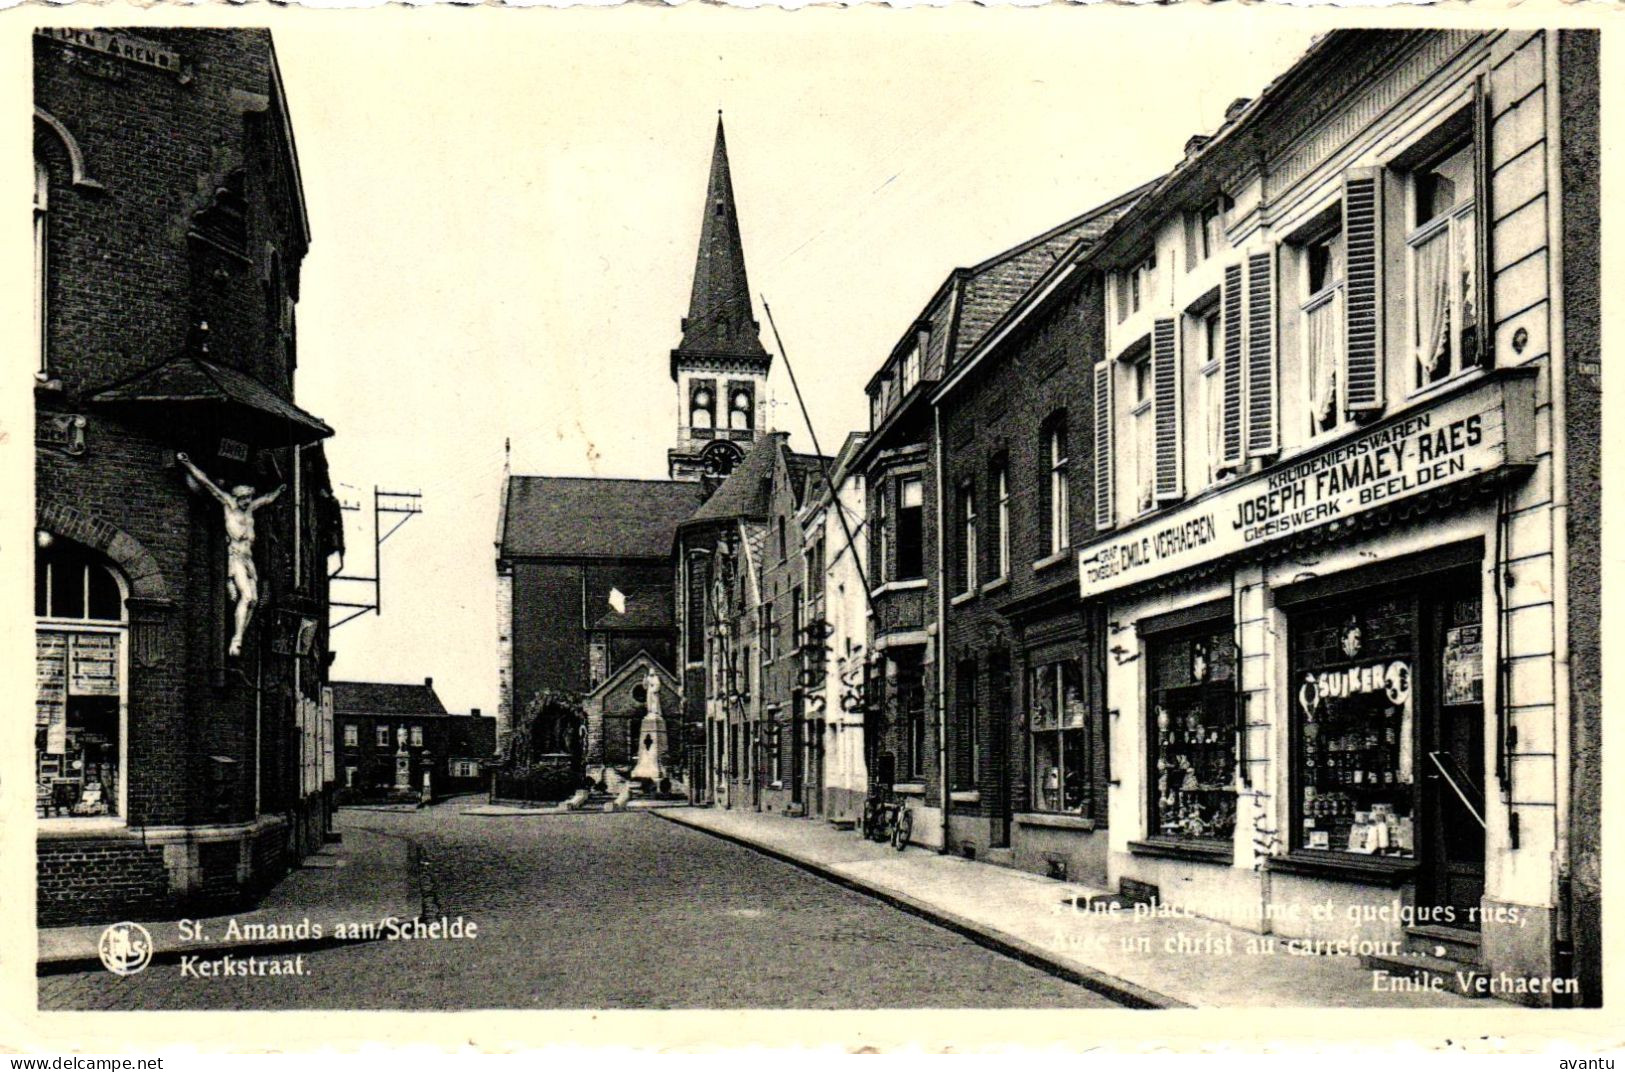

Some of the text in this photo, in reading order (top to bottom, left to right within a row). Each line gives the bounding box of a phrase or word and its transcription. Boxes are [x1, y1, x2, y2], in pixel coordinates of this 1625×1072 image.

[1232, 415, 1482, 530] JOSEPH FAMAEY-RAES
[1268, 413, 1431, 490] KRUIDENIERSWAREN
[1359, 454, 1465, 505] BEELDEN
[1120, 512, 1217, 571] EMILE VERHAEREN
[1318, 663, 1386, 698] SUIKER
